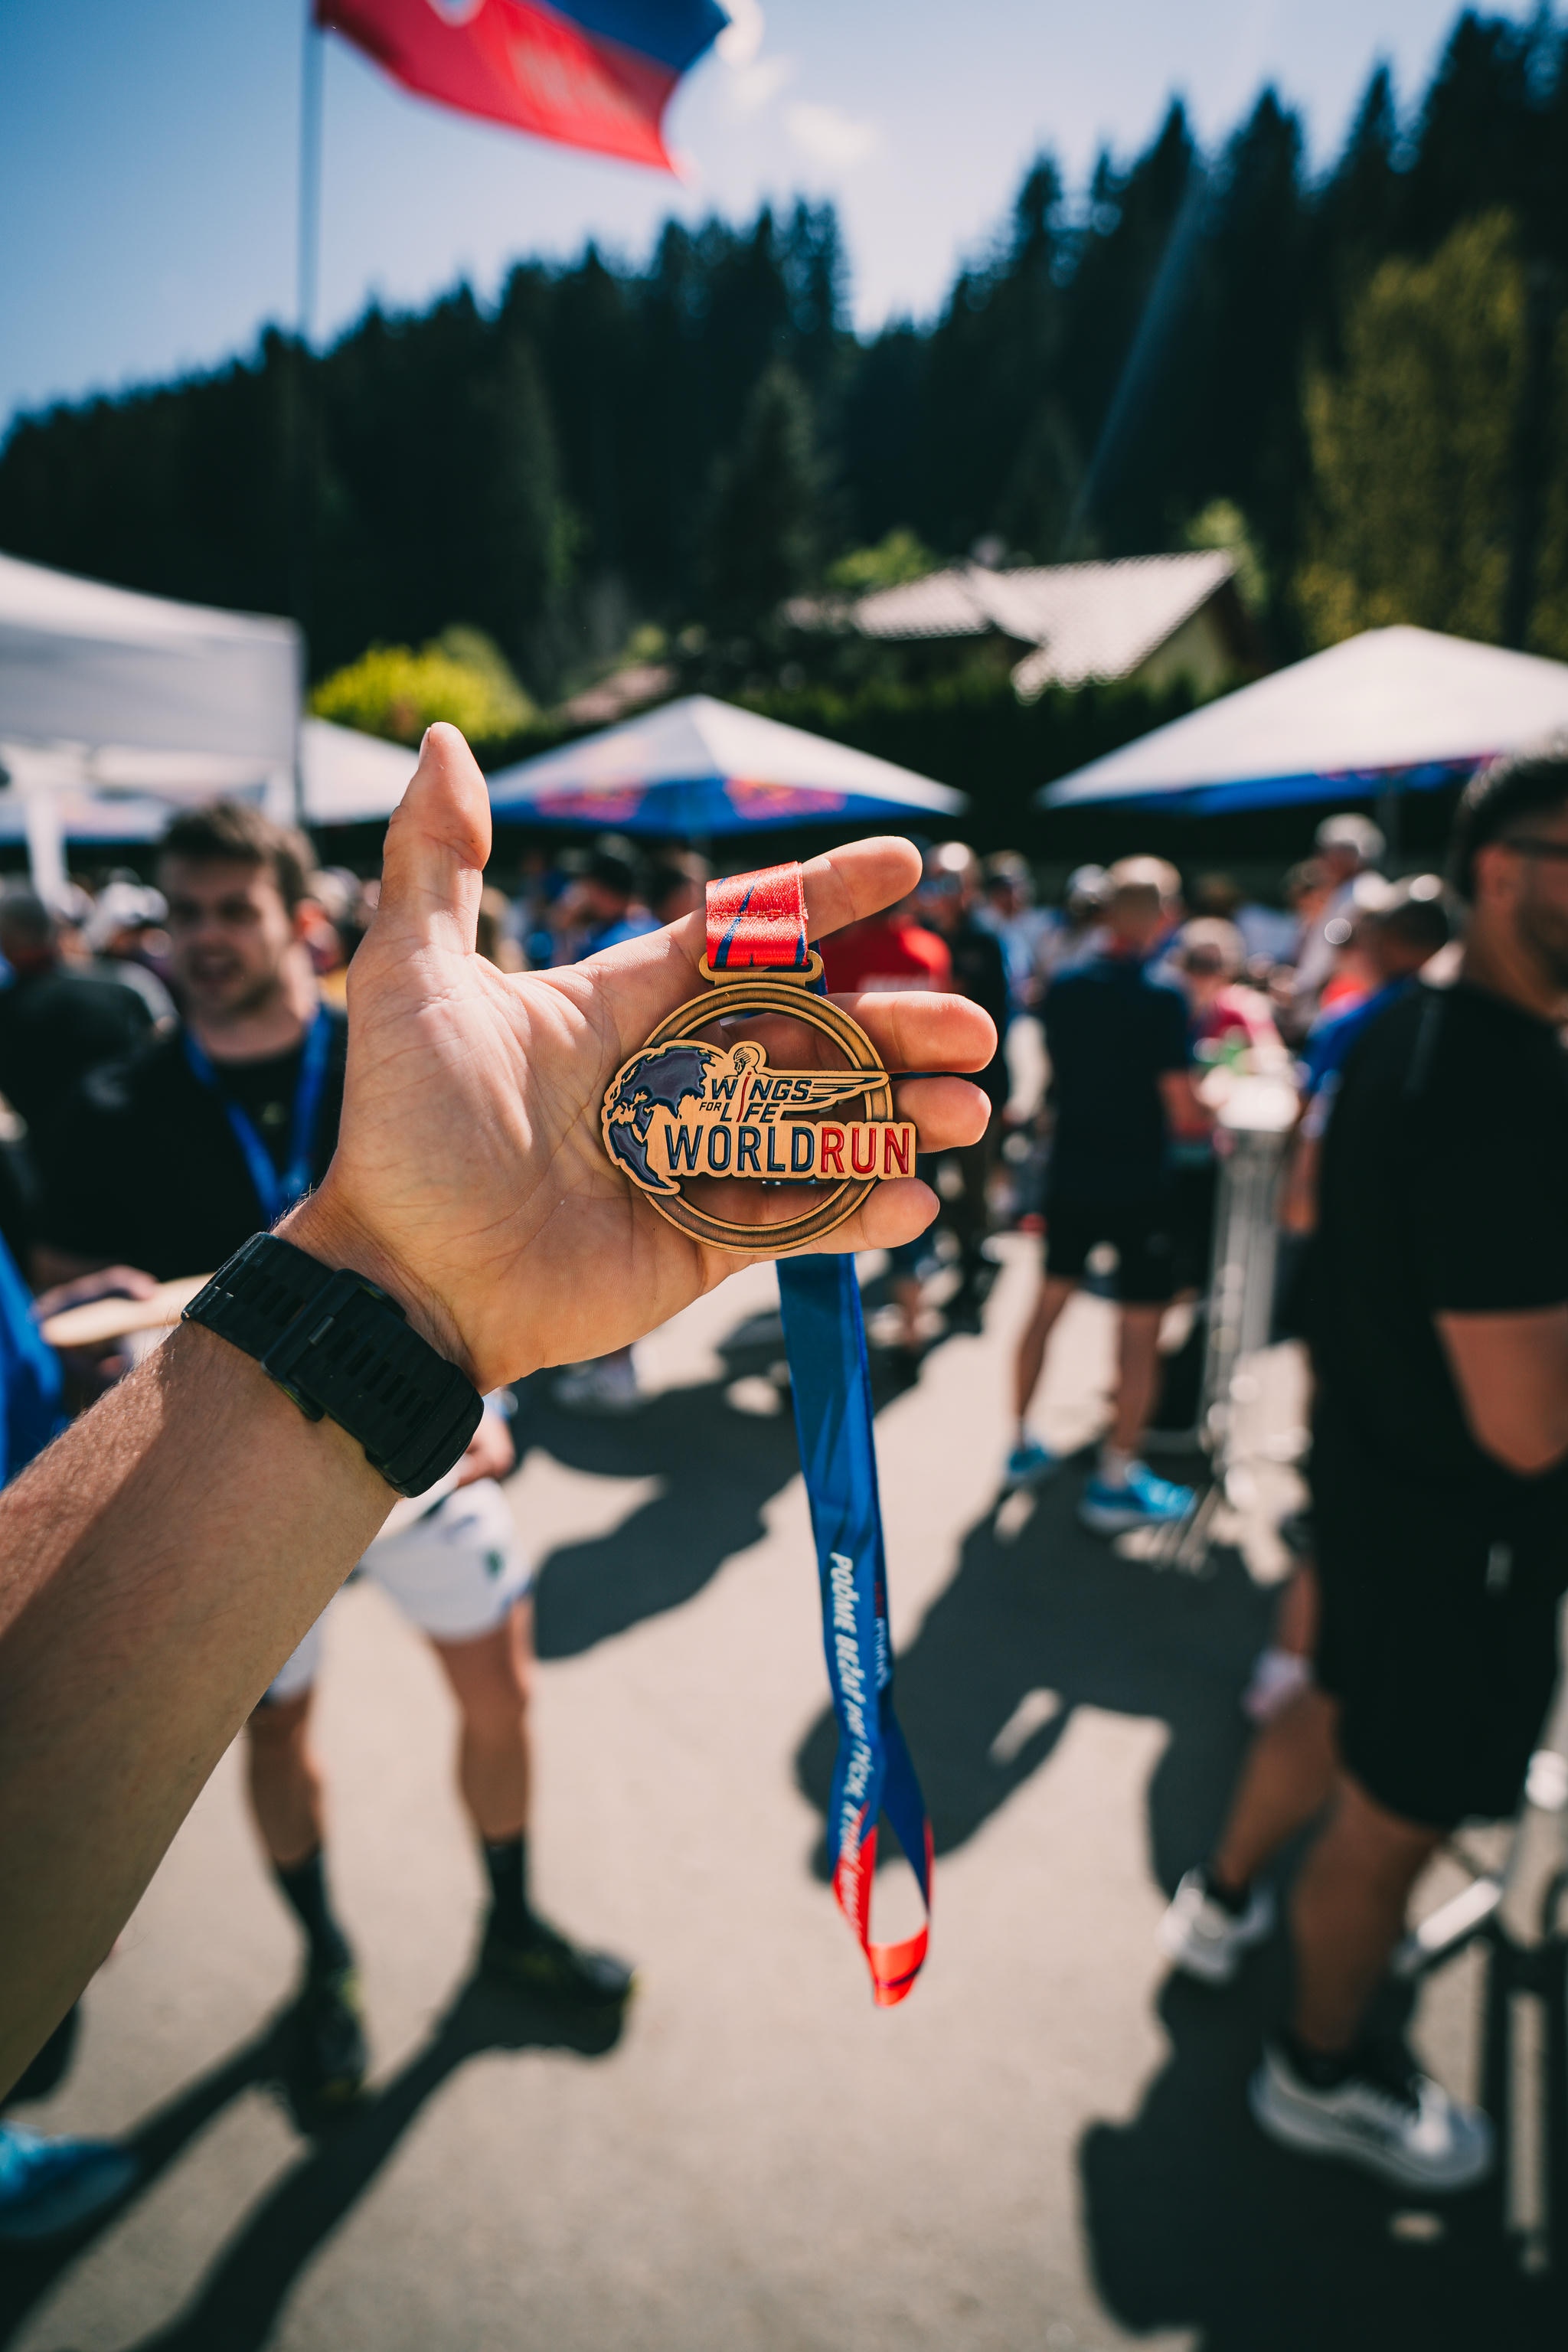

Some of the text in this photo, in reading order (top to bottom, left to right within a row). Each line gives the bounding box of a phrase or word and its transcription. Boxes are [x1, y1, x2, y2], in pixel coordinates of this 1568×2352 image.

[711, 1073, 812, 1100] WINGS
[699, 1102, 780, 1122] FOR LIFE
